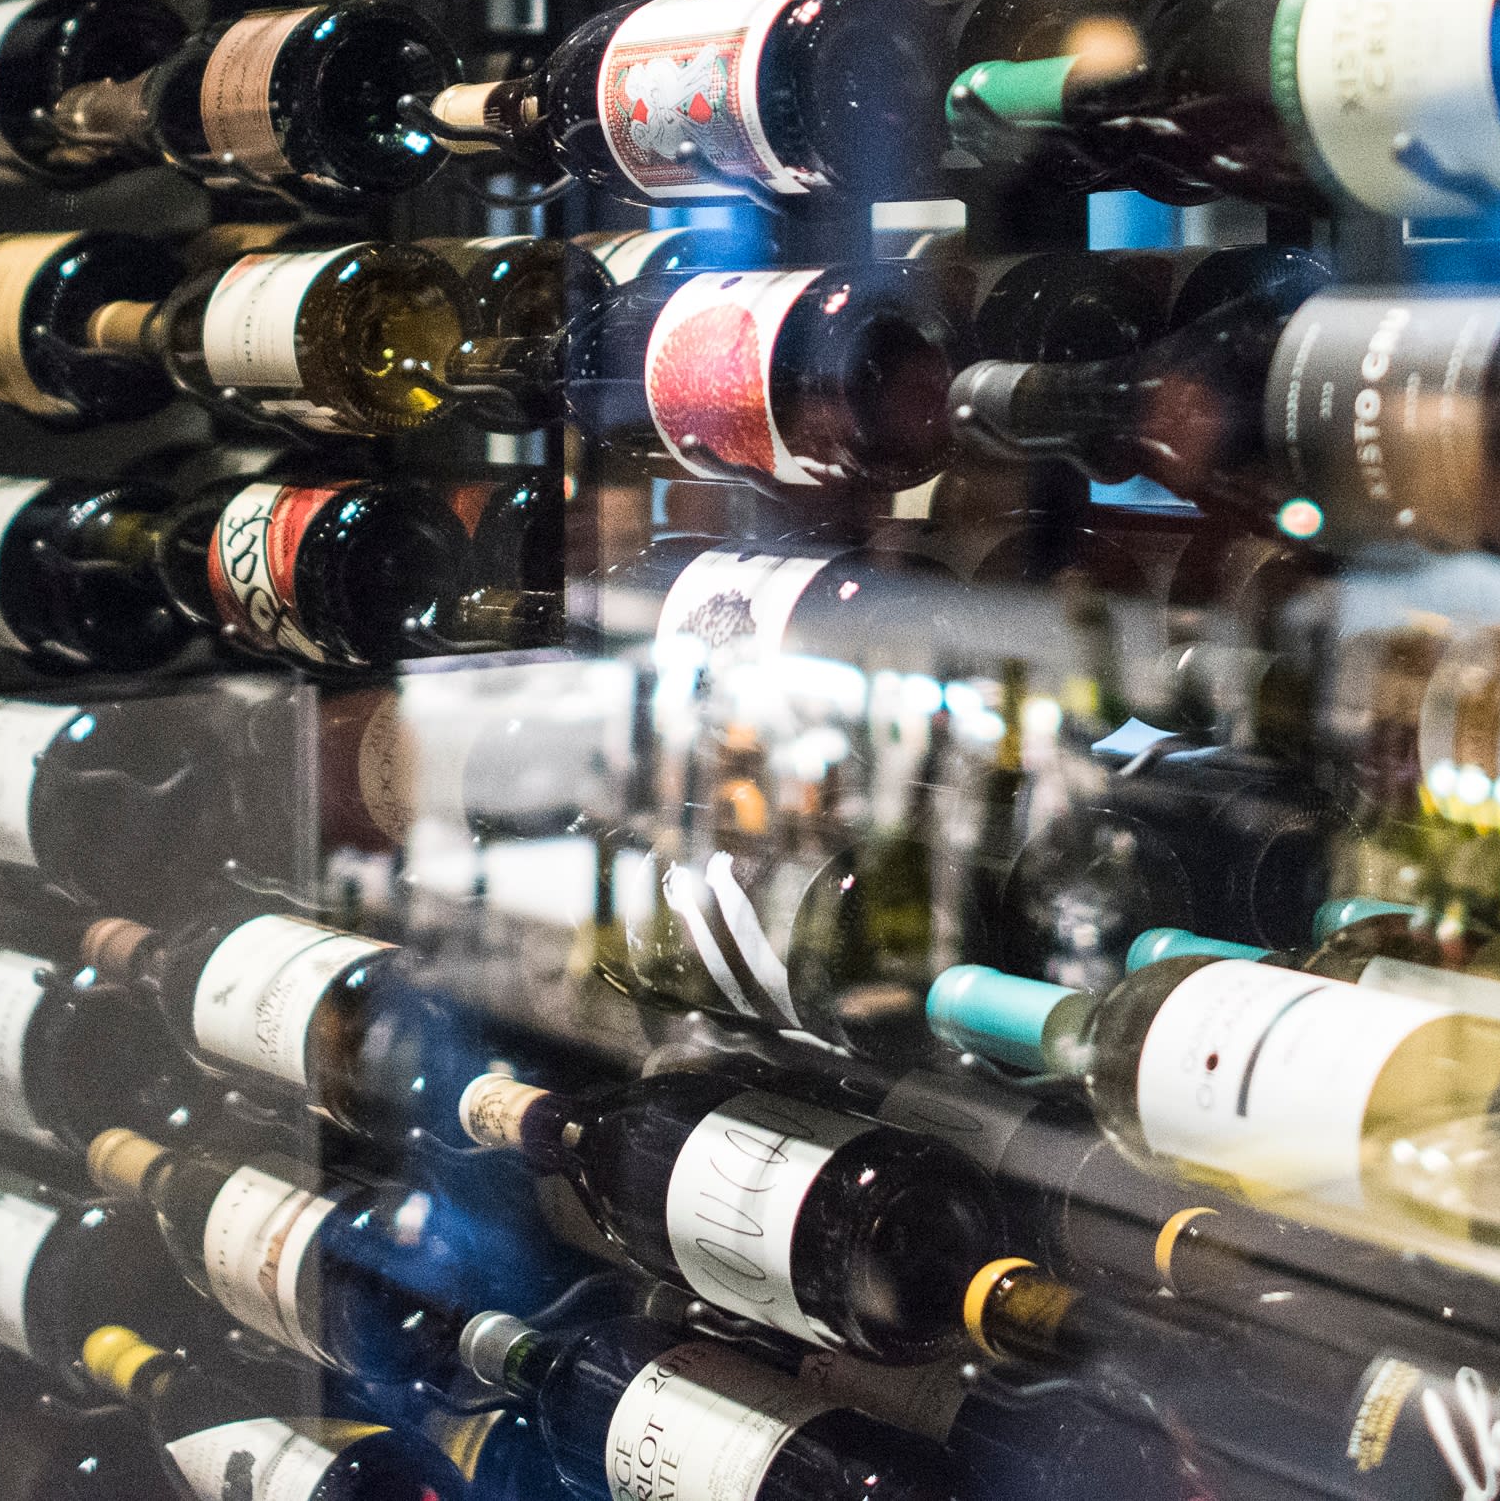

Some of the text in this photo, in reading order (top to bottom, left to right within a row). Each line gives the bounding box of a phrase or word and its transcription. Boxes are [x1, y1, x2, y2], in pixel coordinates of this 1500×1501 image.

[613, 1435, 635, 1501] DGE
[636, 1413, 665, 1501] RLOT
[657, 1444, 681, 1501] ATE
